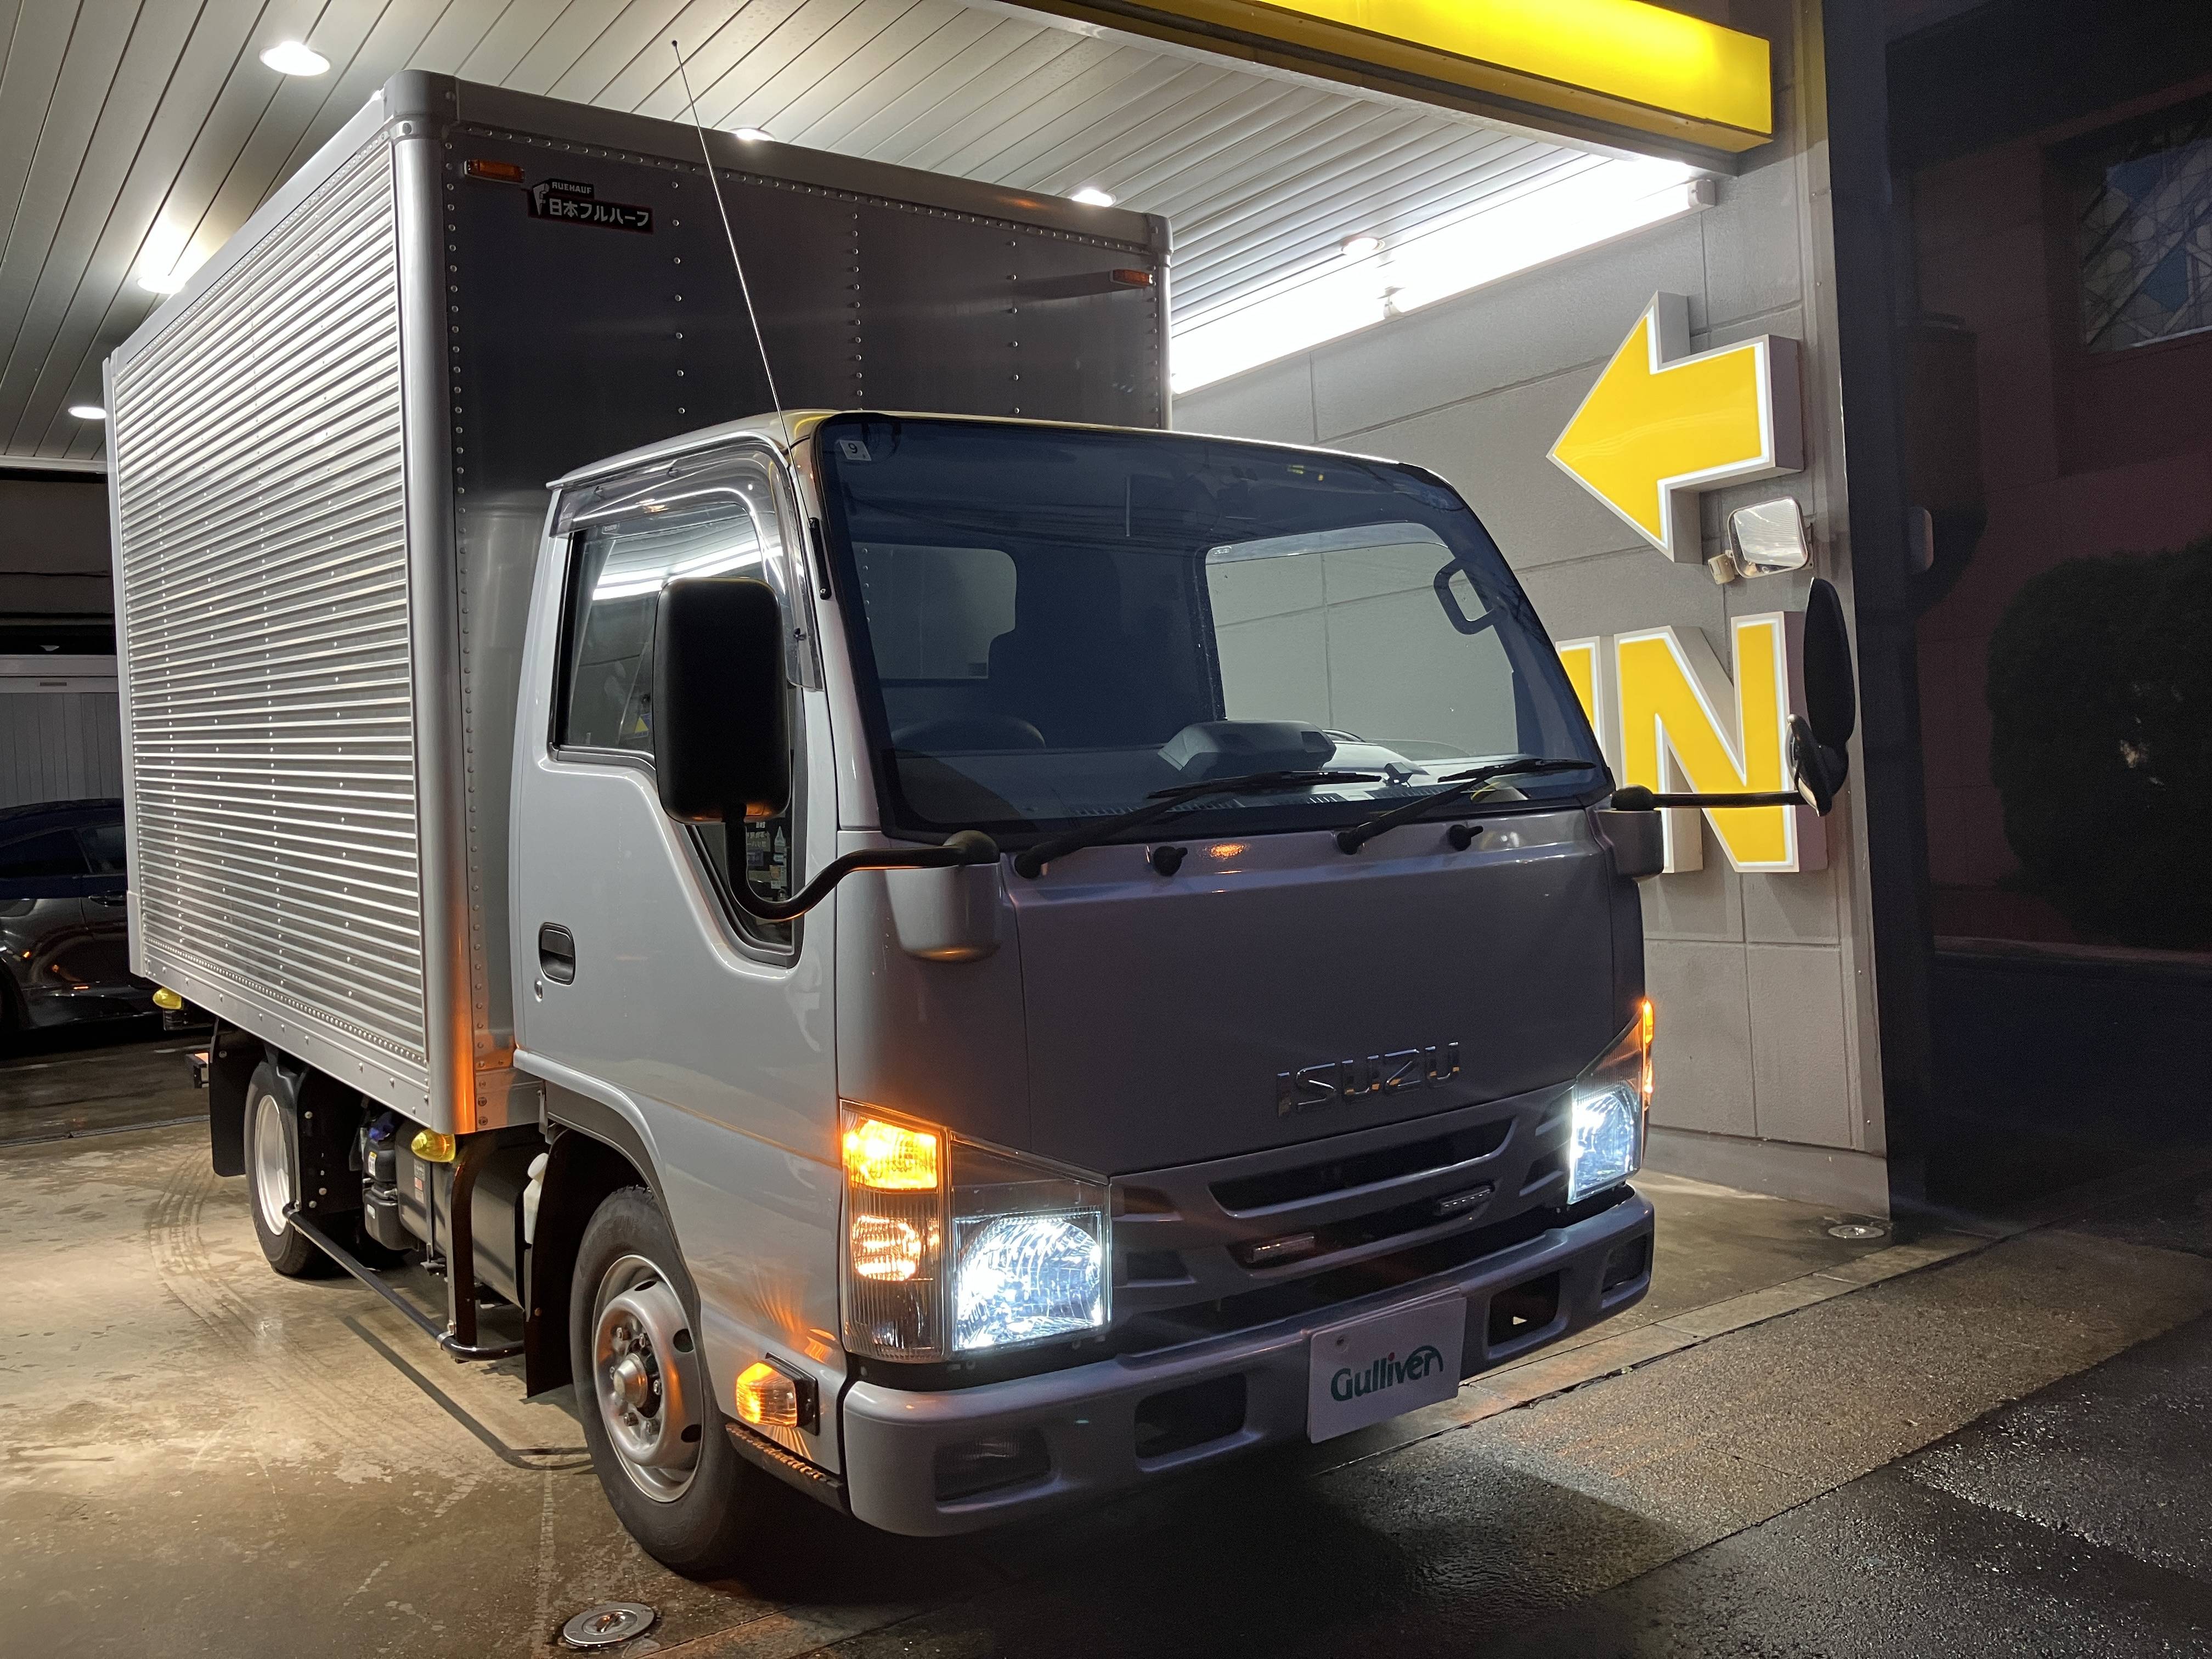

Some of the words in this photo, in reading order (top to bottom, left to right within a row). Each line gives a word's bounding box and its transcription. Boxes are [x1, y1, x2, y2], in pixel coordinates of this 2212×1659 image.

[549, 198, 649, 227] 日本フルハーフ
[848, 443, 857, 454] 9
[1556, 611, 1799, 872] N
[1277, 1042, 1460, 1118] ISUZU
[1330, 1345, 1443, 1401] Gulliver
